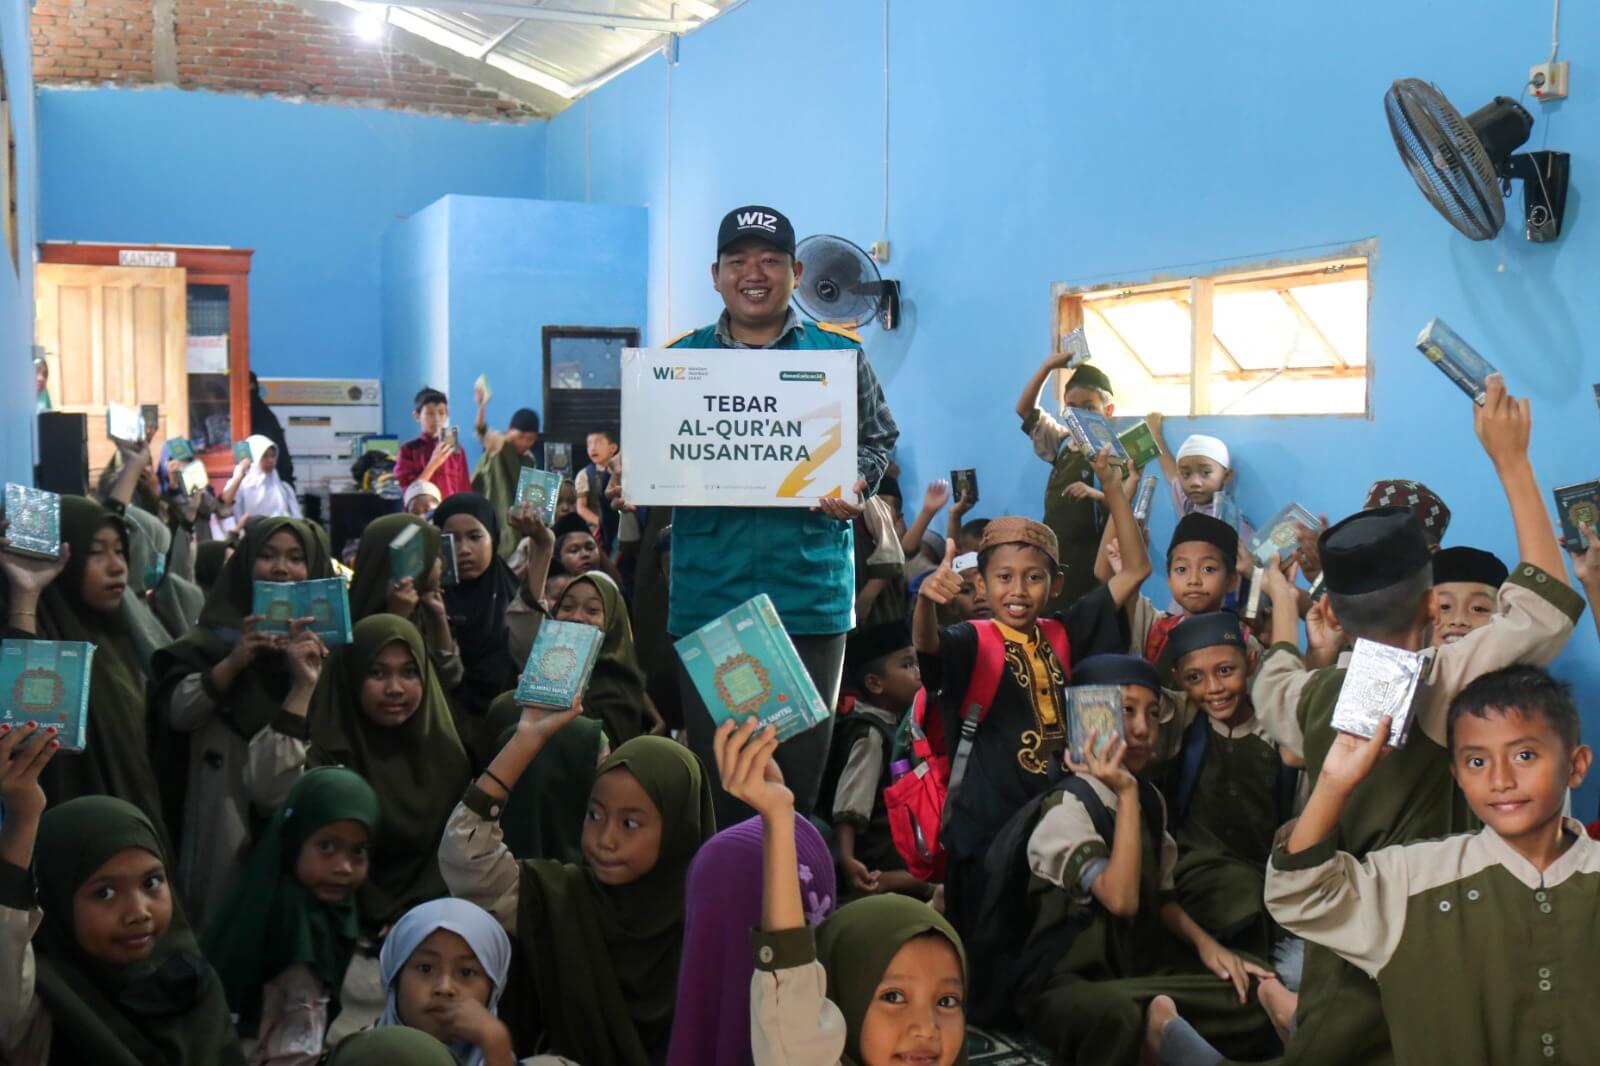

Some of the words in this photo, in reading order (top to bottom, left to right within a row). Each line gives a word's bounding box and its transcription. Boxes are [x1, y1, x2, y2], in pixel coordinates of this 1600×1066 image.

[736, 211, 778, 230] WIZ
[120, 252, 171, 266] KANTOR
[703, 395, 778, 413] TEBAR
[678, 418, 802, 440] AL-QUR'AN
[669, 443, 811, 461] NUSANTARA
